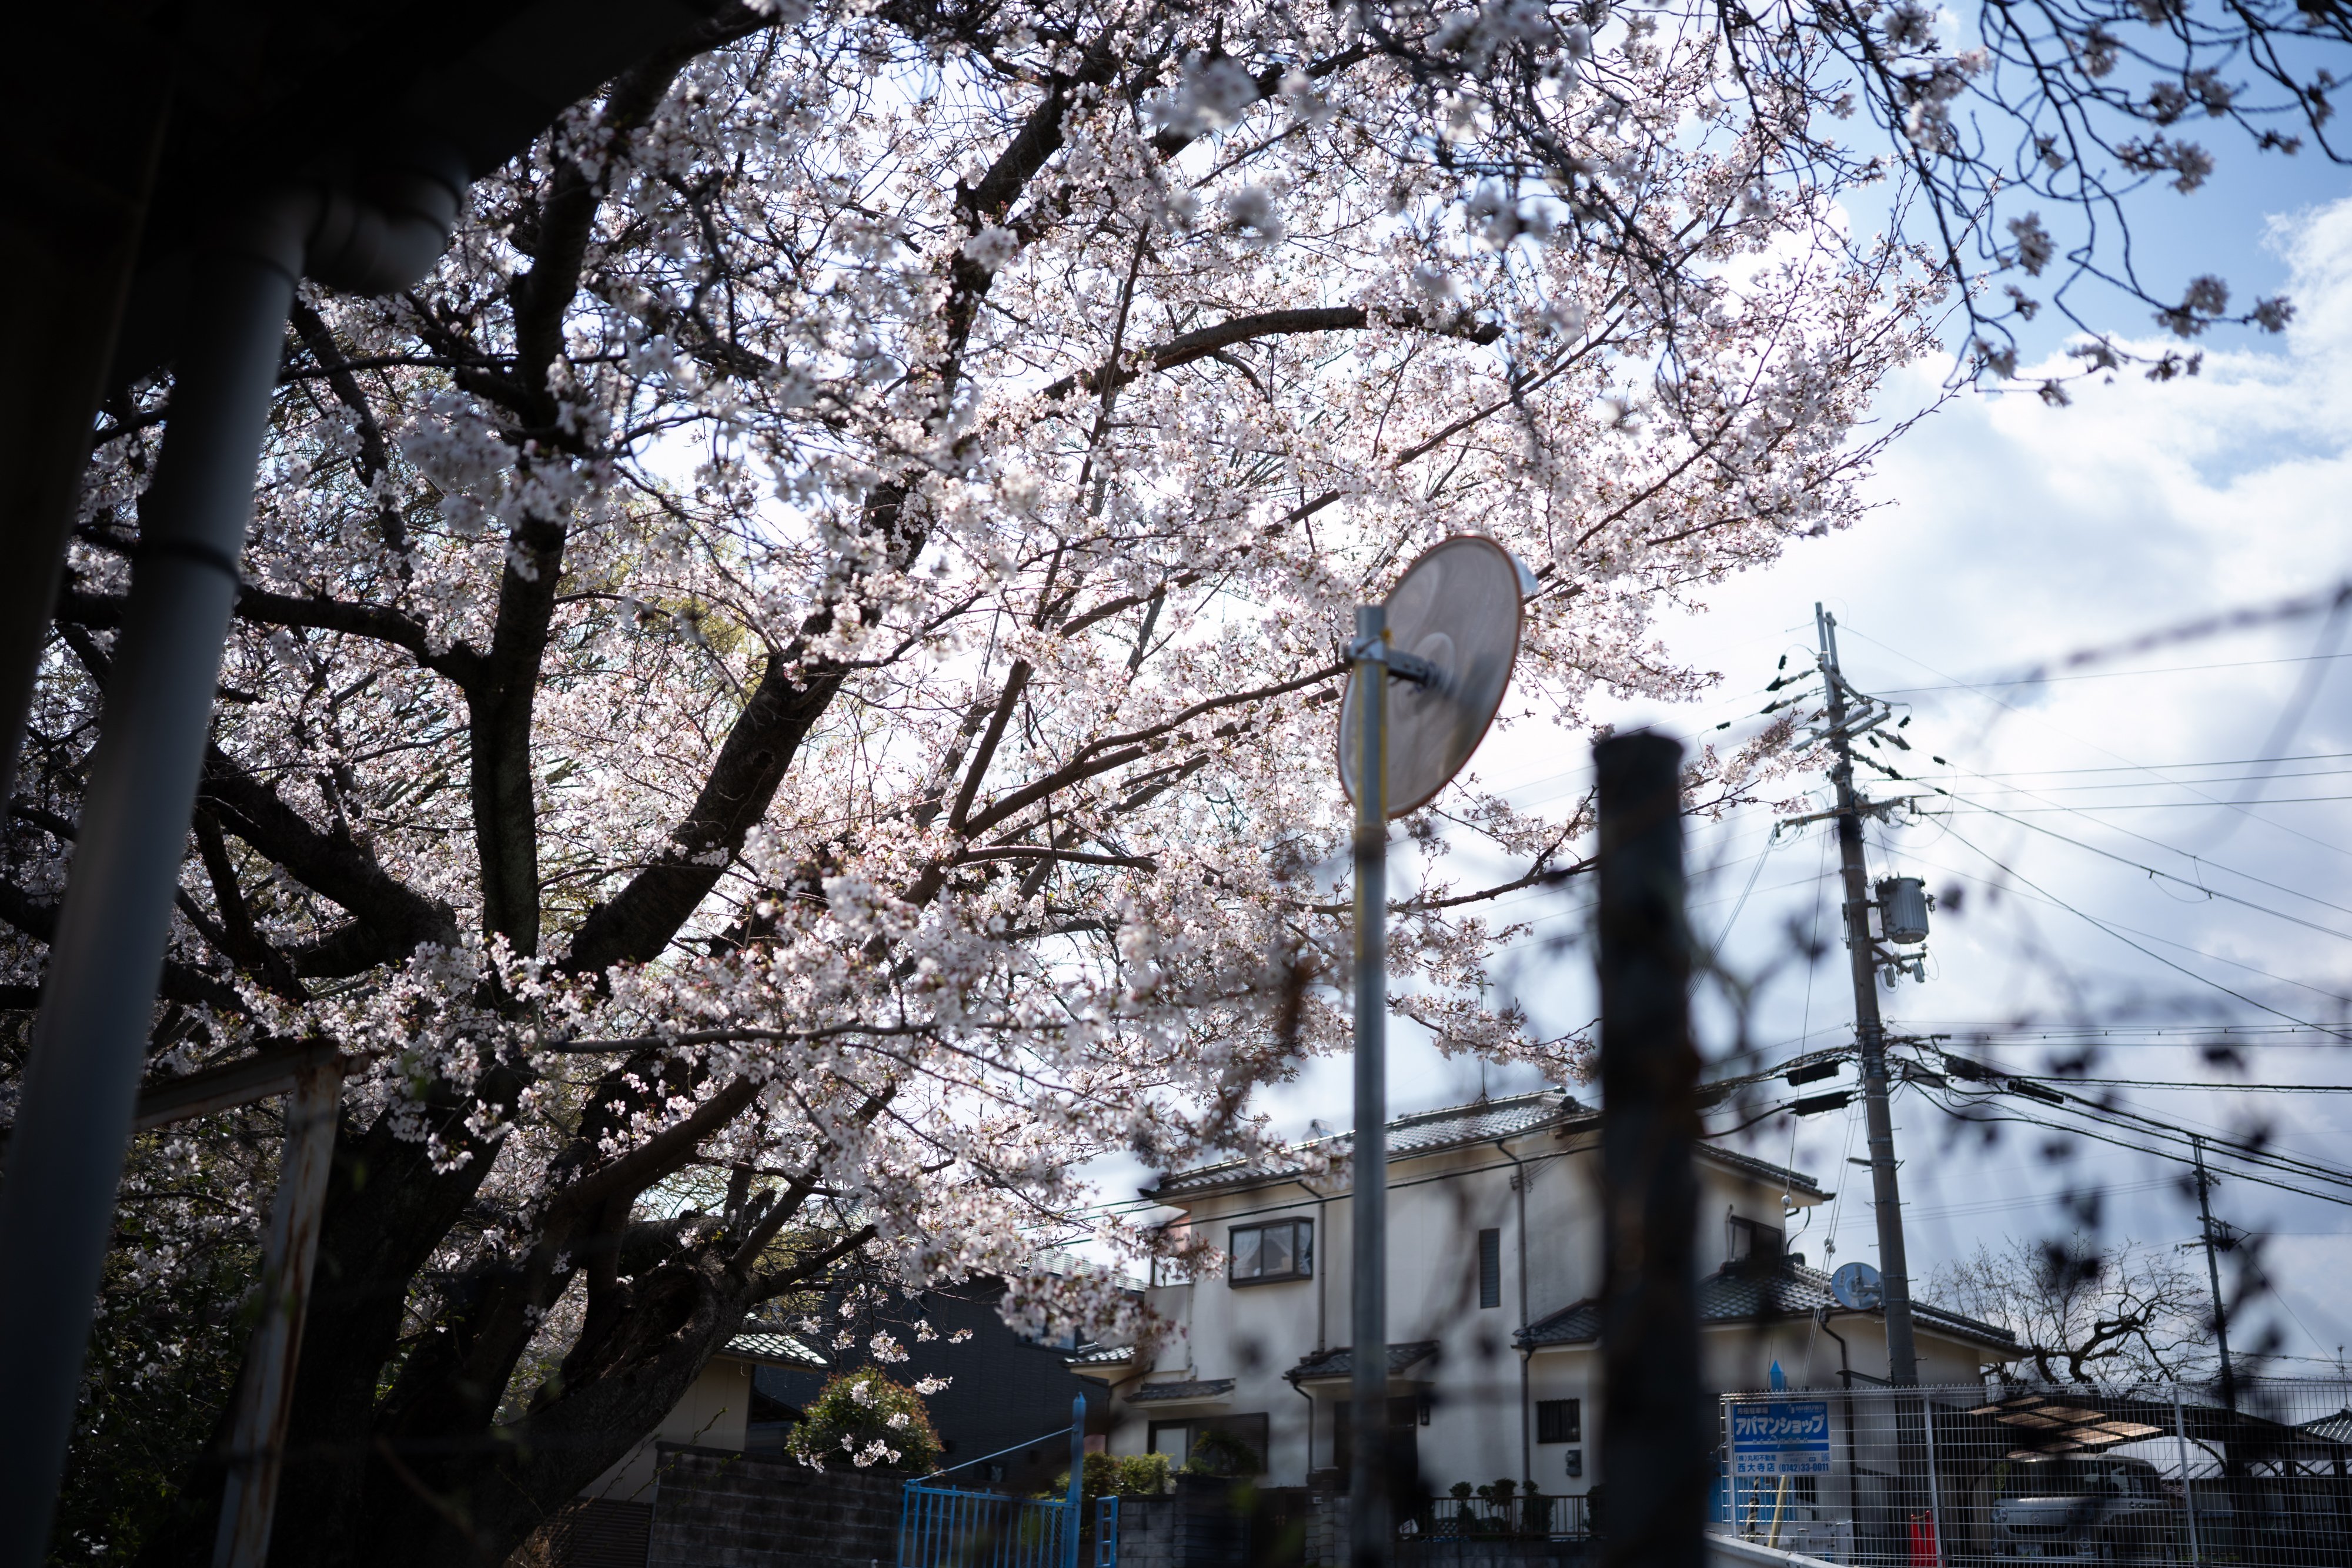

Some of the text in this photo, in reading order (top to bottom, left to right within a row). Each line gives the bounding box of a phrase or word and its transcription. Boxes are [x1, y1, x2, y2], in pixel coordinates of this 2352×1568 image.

[1736, 1414, 1825, 1435] アパマンショップ
[1736, 1454, 1777, 1462] (株)丸和不動産
[1738, 1462, 1829, 1473] 西大寺店 (0742)33-0011
